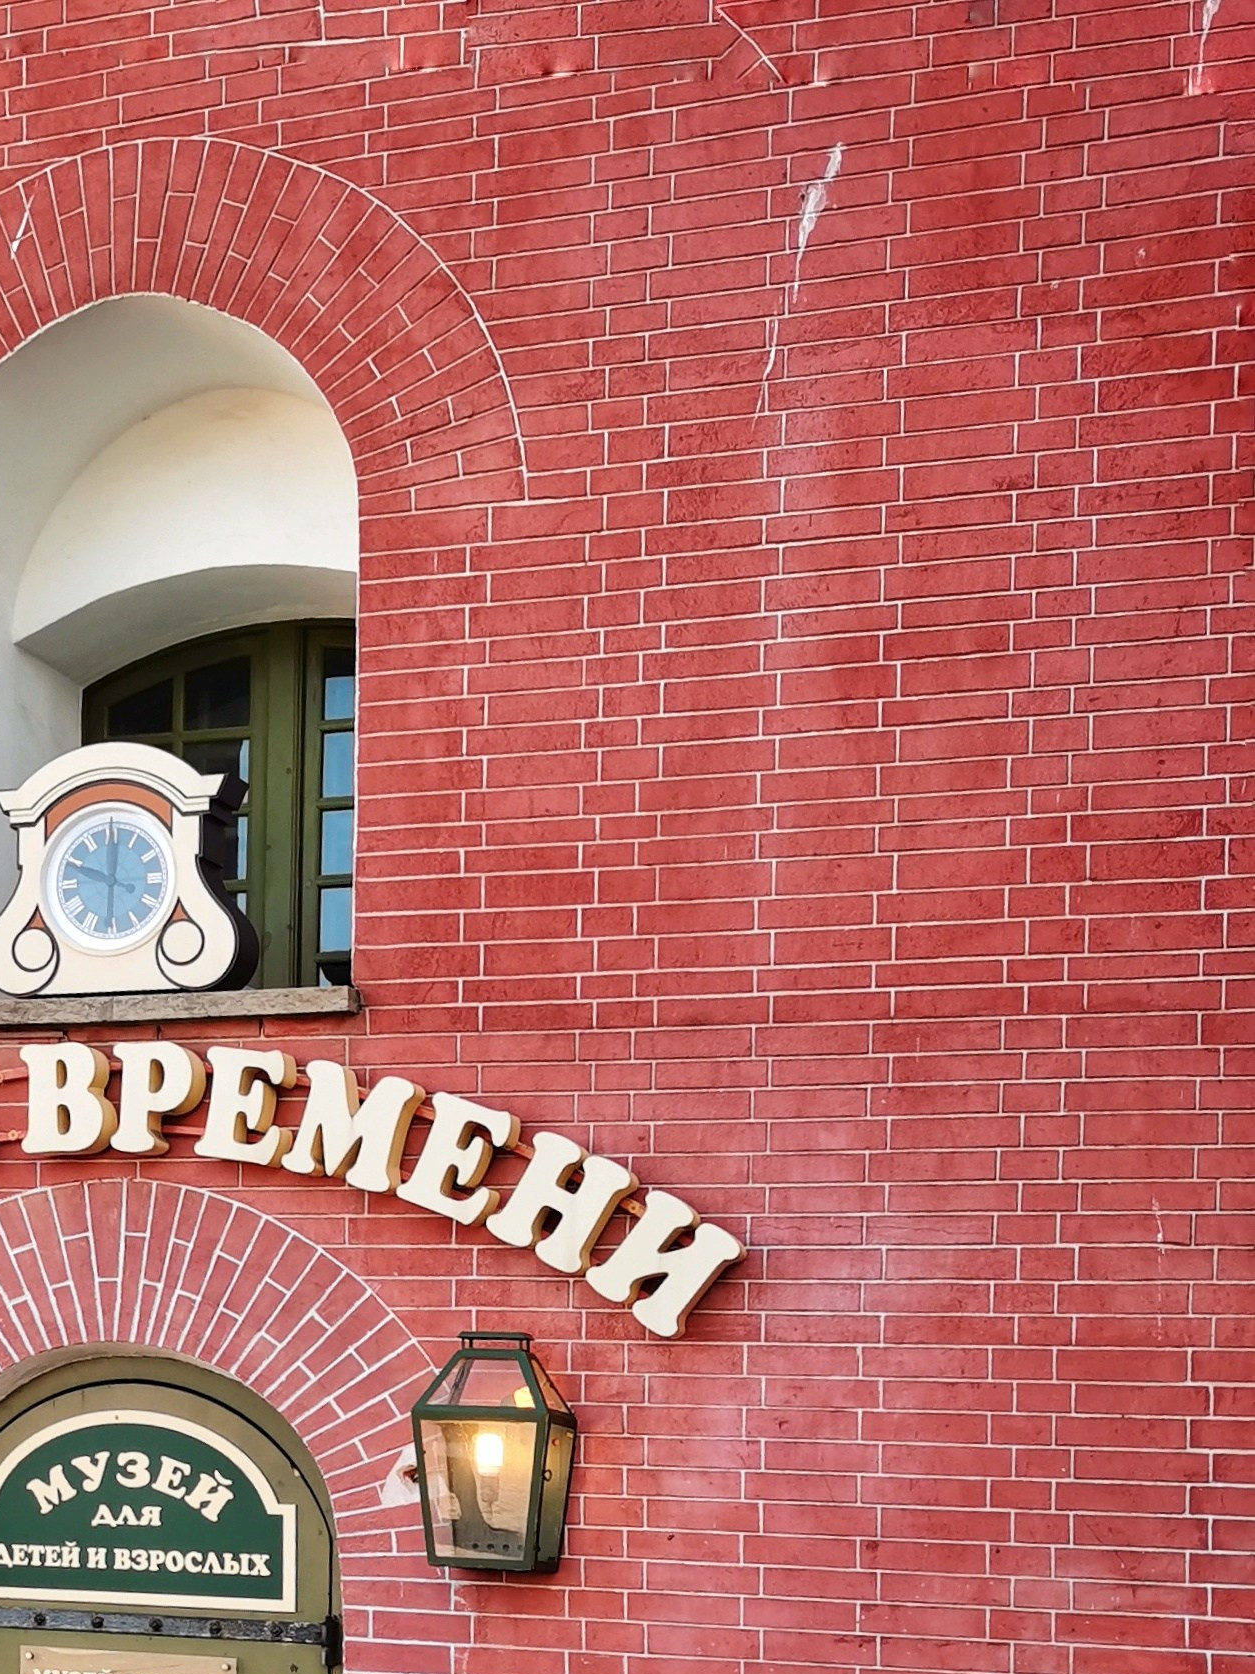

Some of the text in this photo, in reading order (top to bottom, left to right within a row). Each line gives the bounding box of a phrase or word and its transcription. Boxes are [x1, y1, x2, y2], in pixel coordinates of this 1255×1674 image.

[20, 1041, 745, 1338] ВРЕМЕНИ
[26, 1451, 234, 1522] МУЗЕЙ
[91, 1504, 163, 1527] ДЛЯ
[86, 1547, 107, 1569] И
[113, 1548, 272, 1577] ВЗРОСЛЫХ
